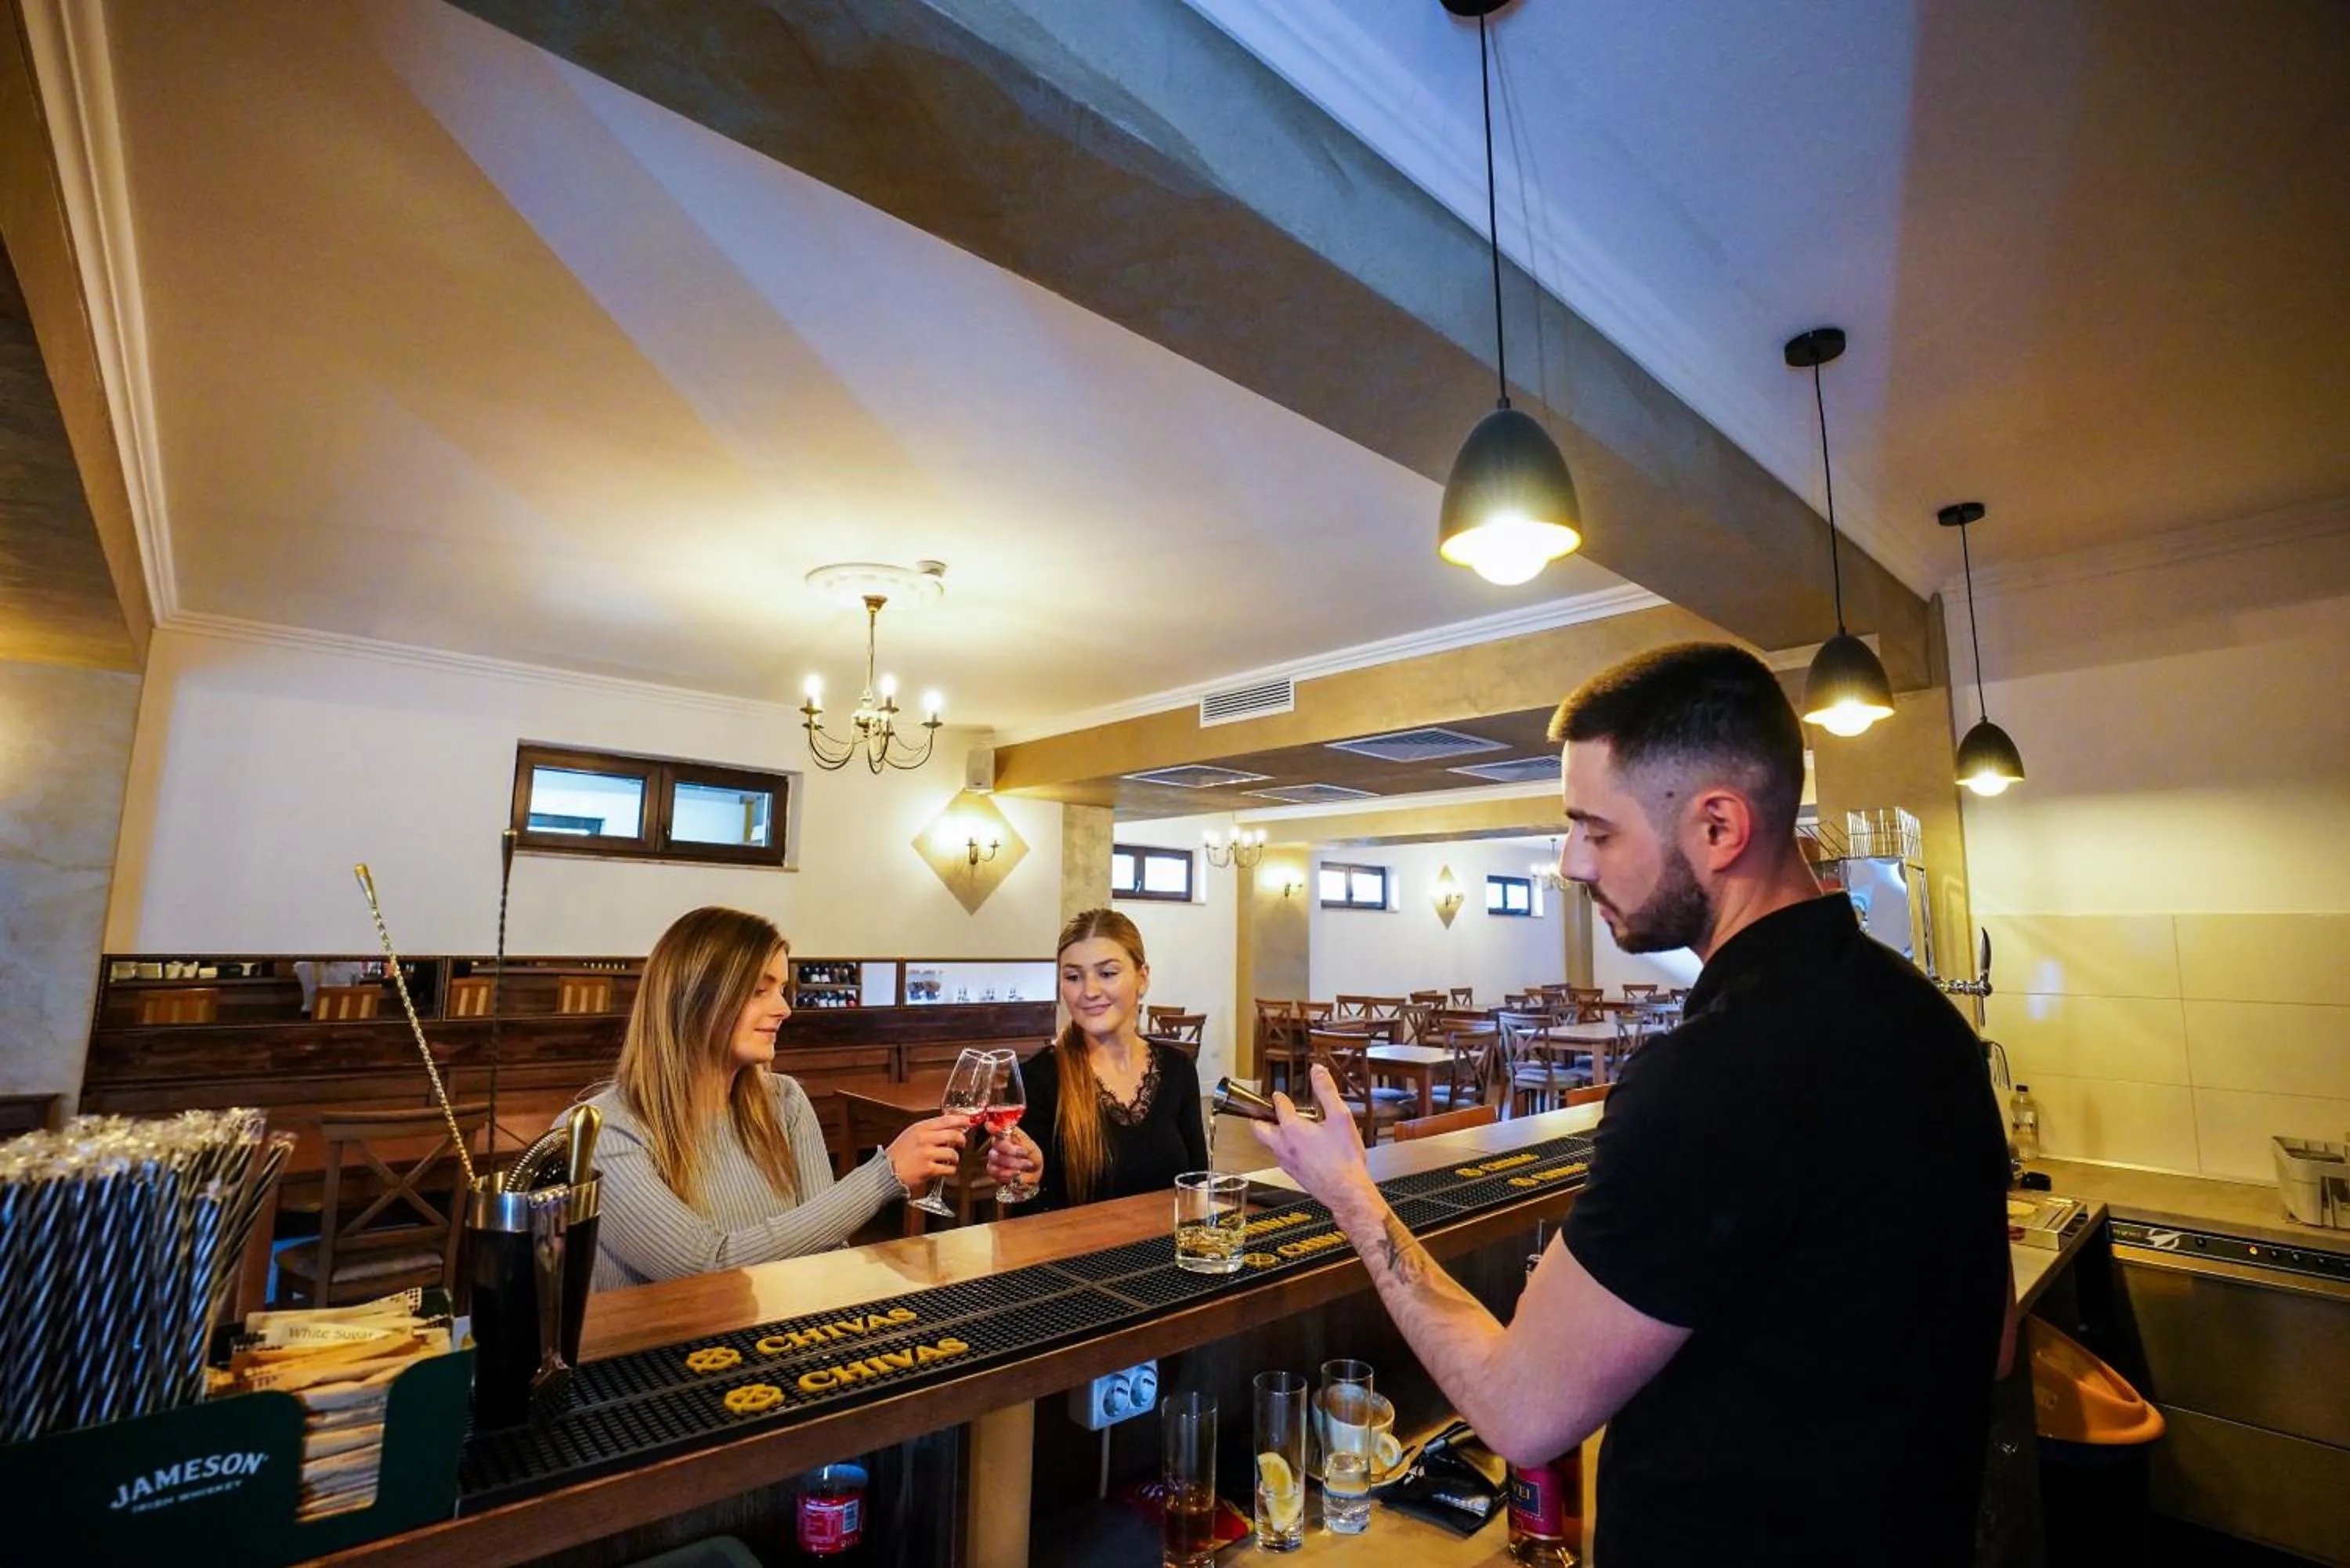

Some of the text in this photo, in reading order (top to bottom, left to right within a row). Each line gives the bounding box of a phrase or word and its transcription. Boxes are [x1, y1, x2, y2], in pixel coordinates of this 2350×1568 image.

[756, 1307, 917, 1355] CHIVAS
[797, 1337, 969, 1393] CHIVAS
[110, 1452, 265, 1509] JAMESON
